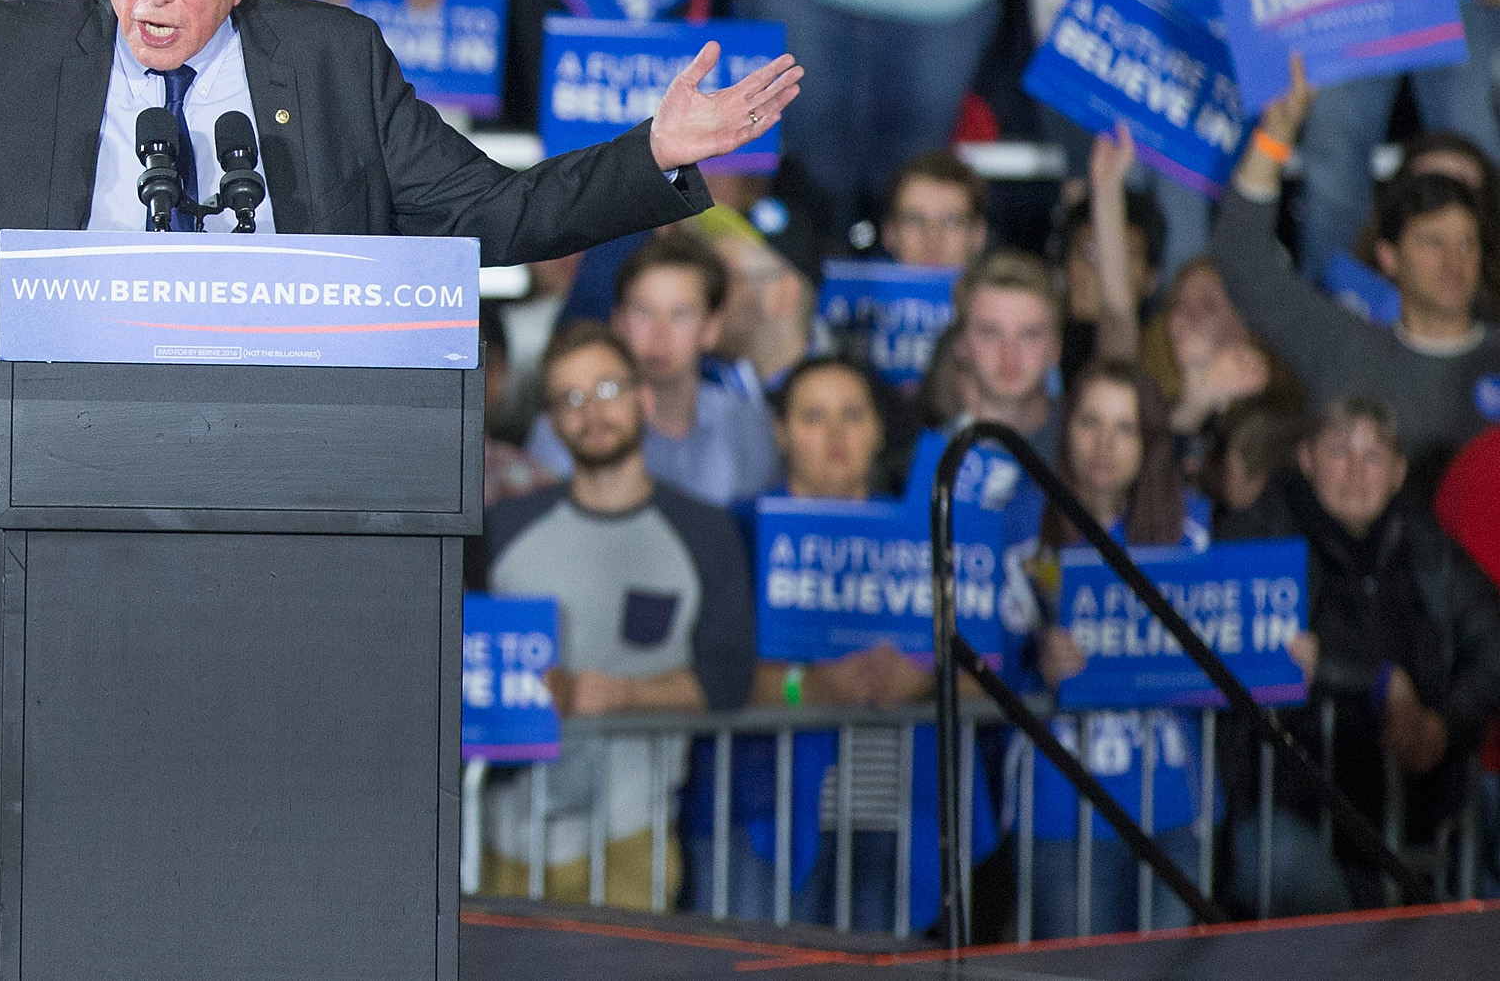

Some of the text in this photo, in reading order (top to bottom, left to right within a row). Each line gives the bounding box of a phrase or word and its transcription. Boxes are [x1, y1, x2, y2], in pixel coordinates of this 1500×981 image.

[555, 51, 582, 83] A
[11, 277, 464, 308] WWW.BERNIESANDERS.COM
[158, 348, 173, 356] PAID
[188, 349, 198, 357] BY
[198, 349, 221, 357] BERNIE
[221, 349, 238, 357] 2016
[243, 350, 260, 359] (NOT
[261, 350, 275, 358] THE
[274, 350, 321, 360] BILLIONAIRES)
[769, 533, 795, 565] A
[768, 569, 933, 617] BELIEVE
[1073, 585, 1098, 619] A
[1251, 578, 1298, 614] TO
[498, 631, 553, 670] TO
[1252, 614, 1298, 652] IN
